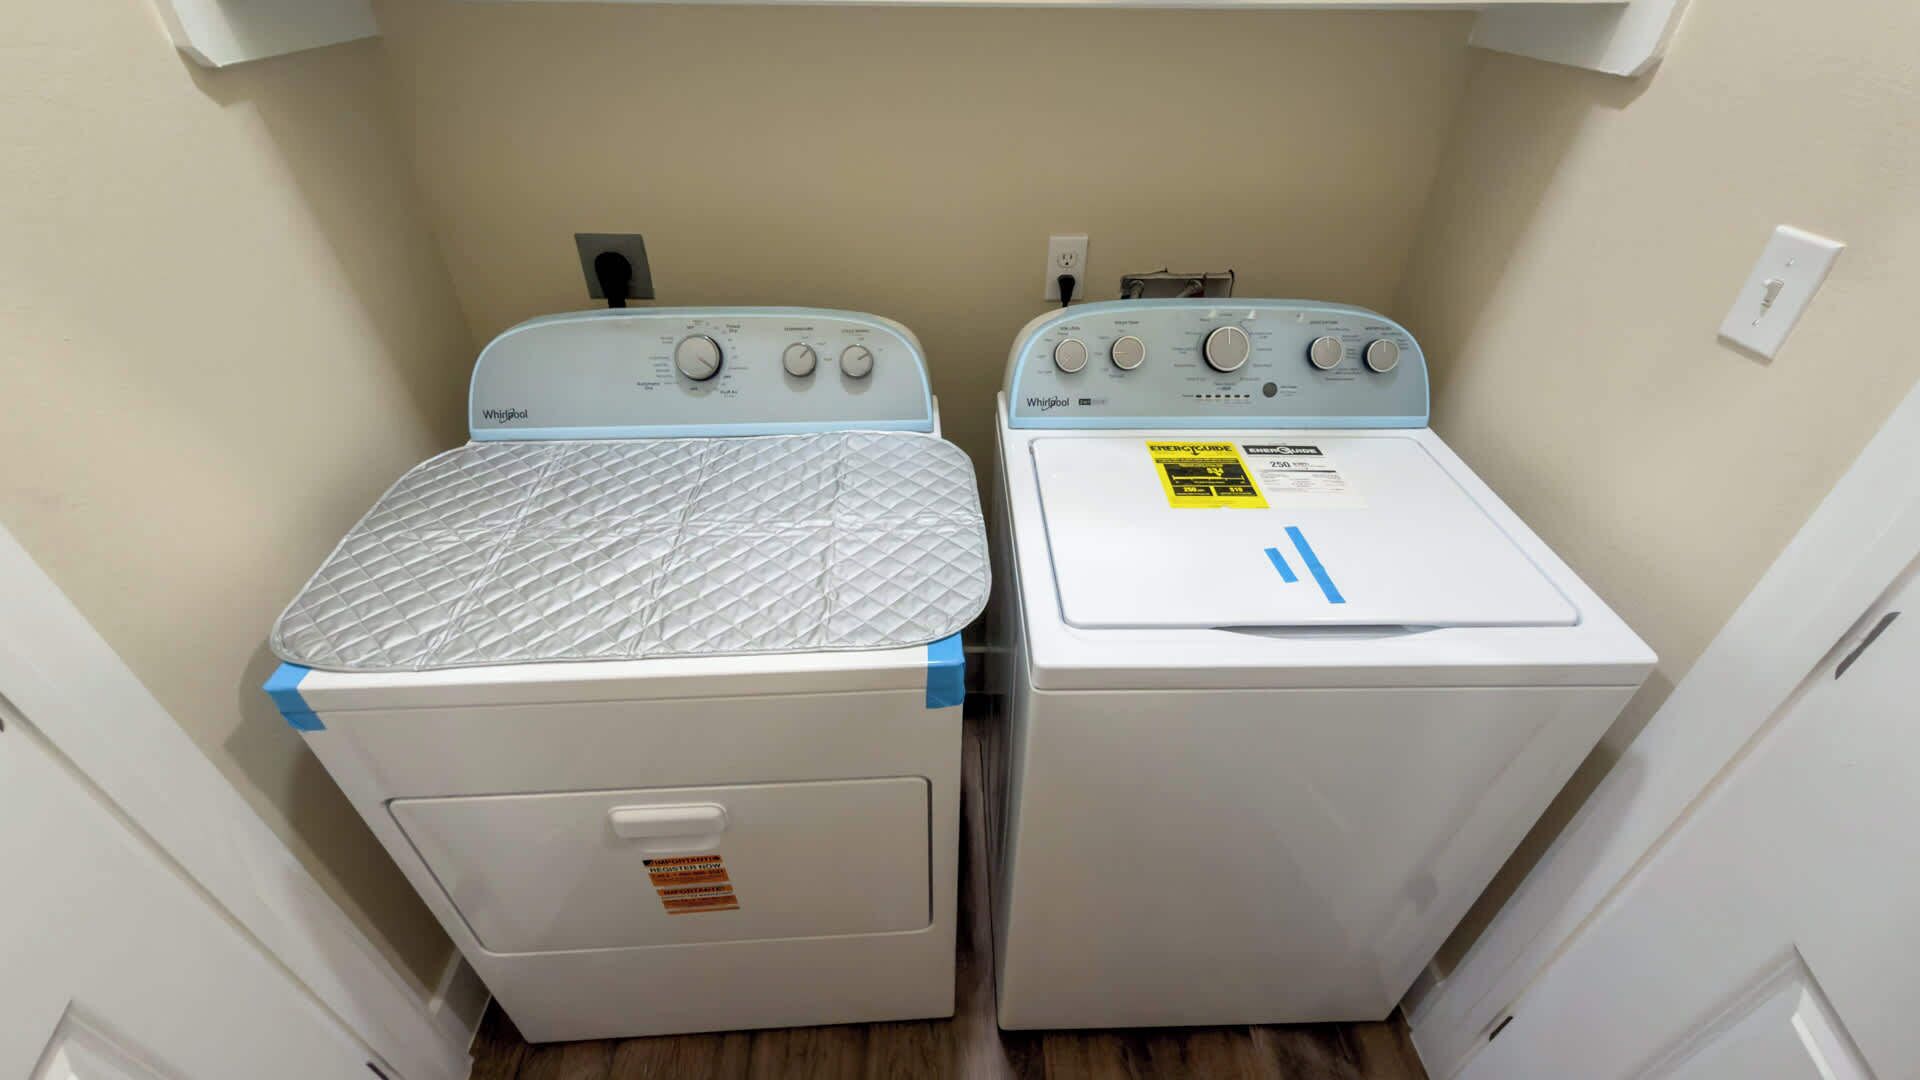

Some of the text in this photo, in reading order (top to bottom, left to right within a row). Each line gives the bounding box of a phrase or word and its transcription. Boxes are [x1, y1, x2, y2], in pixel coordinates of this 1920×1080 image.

[1026, 395, 1070, 411] Whirlpool
[482, 408, 528, 424] Whirlpool
[649, 865, 697, 873] REGISTER
